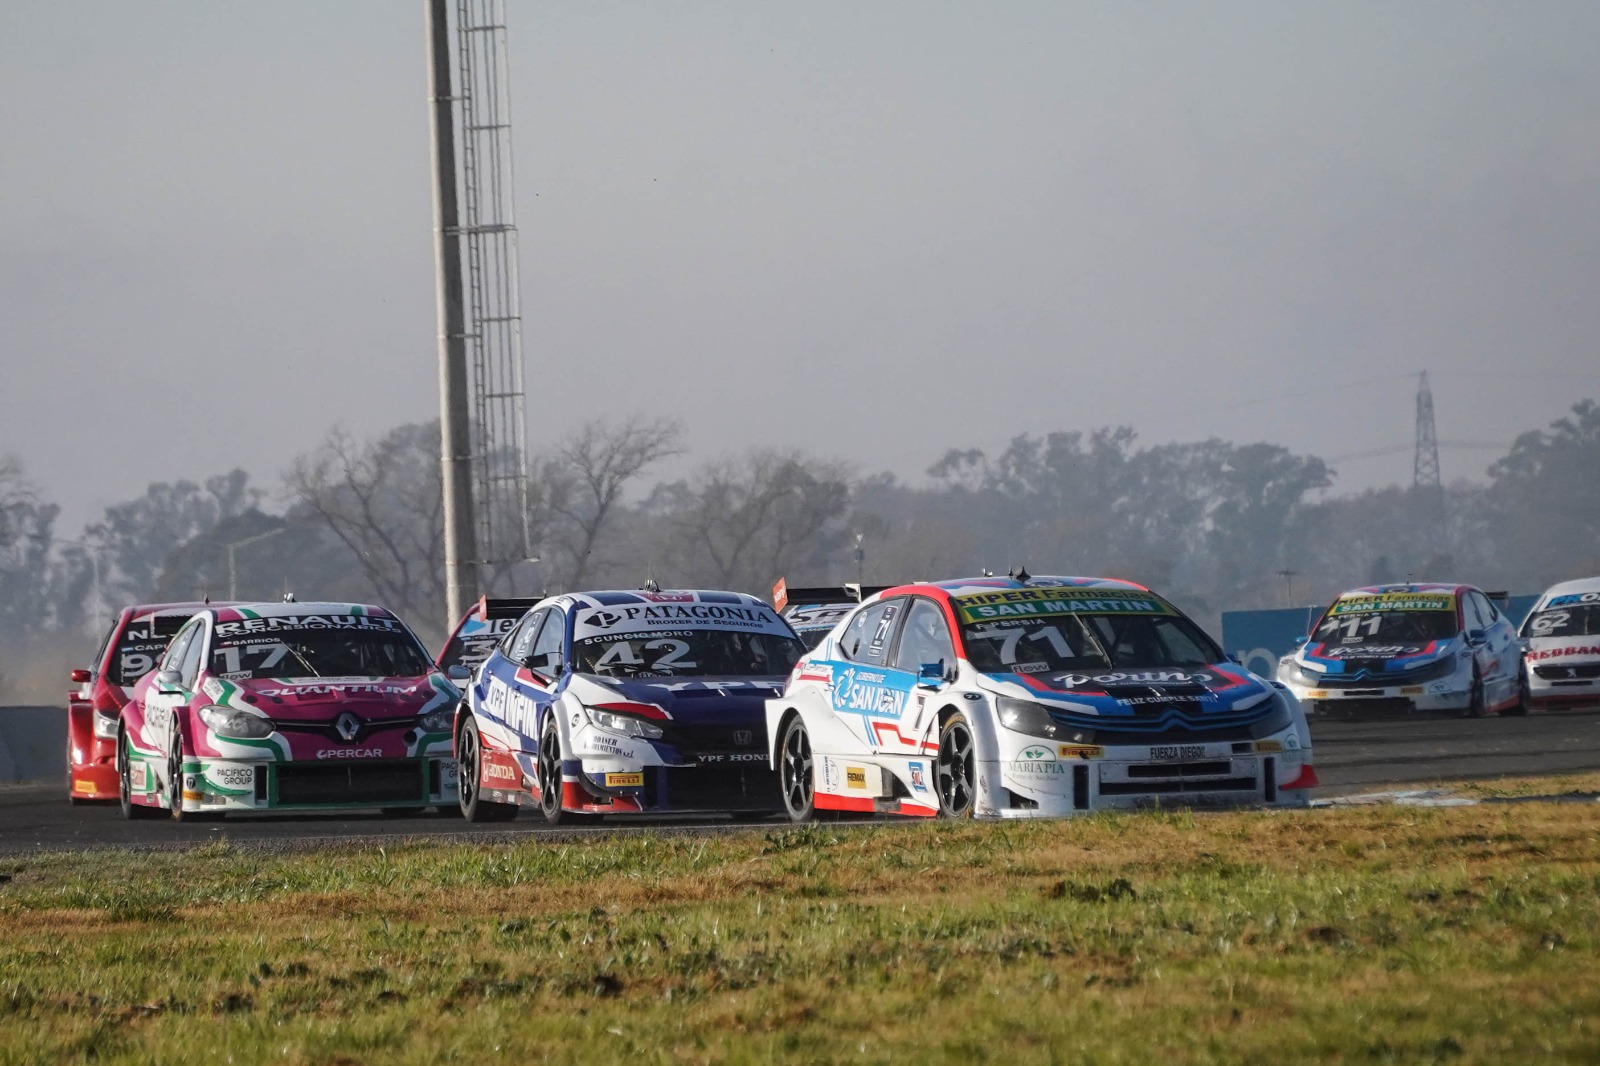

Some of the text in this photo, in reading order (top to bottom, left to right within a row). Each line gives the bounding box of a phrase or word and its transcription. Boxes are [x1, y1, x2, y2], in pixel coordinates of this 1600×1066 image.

[956, 589, 1150, 606] HIPER Farmacias
[982, 600, 1154, 616] SAN MARTIN
[1341, 601, 1443, 612] SAN MARTIN
[624, 605, 773, 624] PATAGONIA
[214, 615, 400, 633] RENAULT
[989, 619, 1046, 628] PERSIA
[1319, 616, 1382, 637] 111
[1532, 613, 1570, 631] 62
[218, 623, 402, 638] CONCESIONARIOS
[875, 619, 891, 640] 71
[232, 637, 281, 646] BARRIOS
[973, 626, 1075, 665] 71
[213, 644, 290, 673] 17
[594, 639, 697, 675] 42
[1013, 663, 1048, 672] flow
[255, 685, 417, 696] QUANTIUM
[646, 681, 786, 692] YPF
[490, 685, 505, 709] YPF
[849, 684, 905, 716] SAN JUAN
[1117, 697, 1147, 707] FELIZ
[1147, 695, 1187, 704] CUMPLE
[1150, 746, 1178, 759] FUERZA
[217, 766, 253, 777] PACÍFICO
[1008, 763, 1066, 774] MARIA PIA
[224, 776, 253, 785] GROUP
[608, 775, 640, 785] PIRELLI
[847, 772, 866, 783] FREMAX
